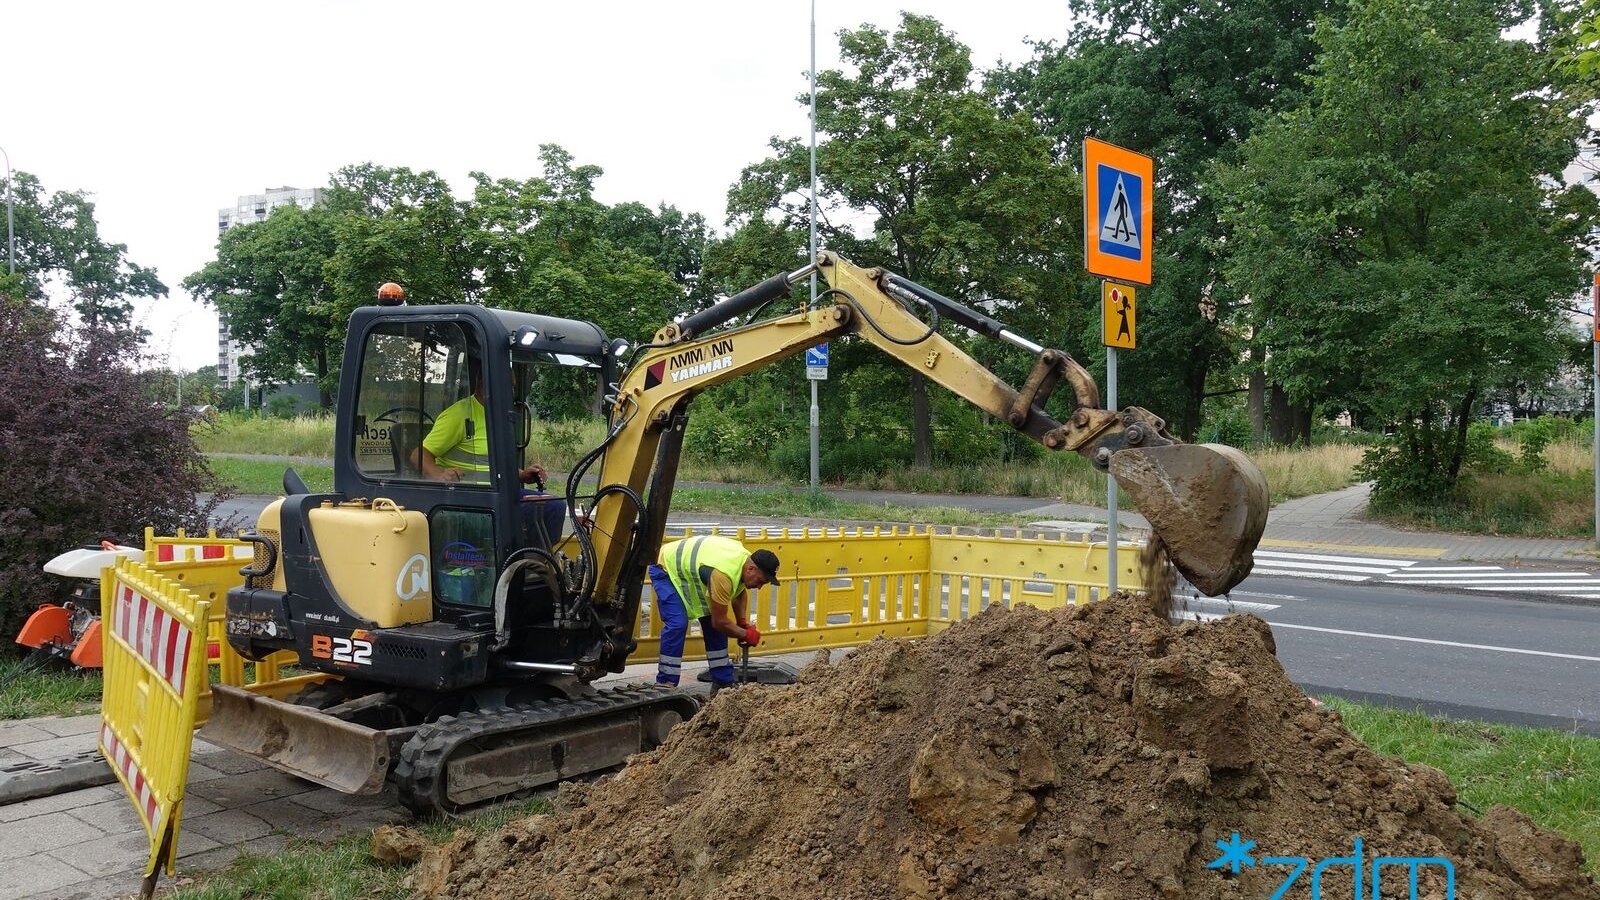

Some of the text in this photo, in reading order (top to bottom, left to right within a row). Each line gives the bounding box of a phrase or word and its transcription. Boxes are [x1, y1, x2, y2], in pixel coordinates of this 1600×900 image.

[670, 339, 733, 370] AMMANN
[671, 355, 732, 383] YANMAR
[312, 634, 373, 666] B22
